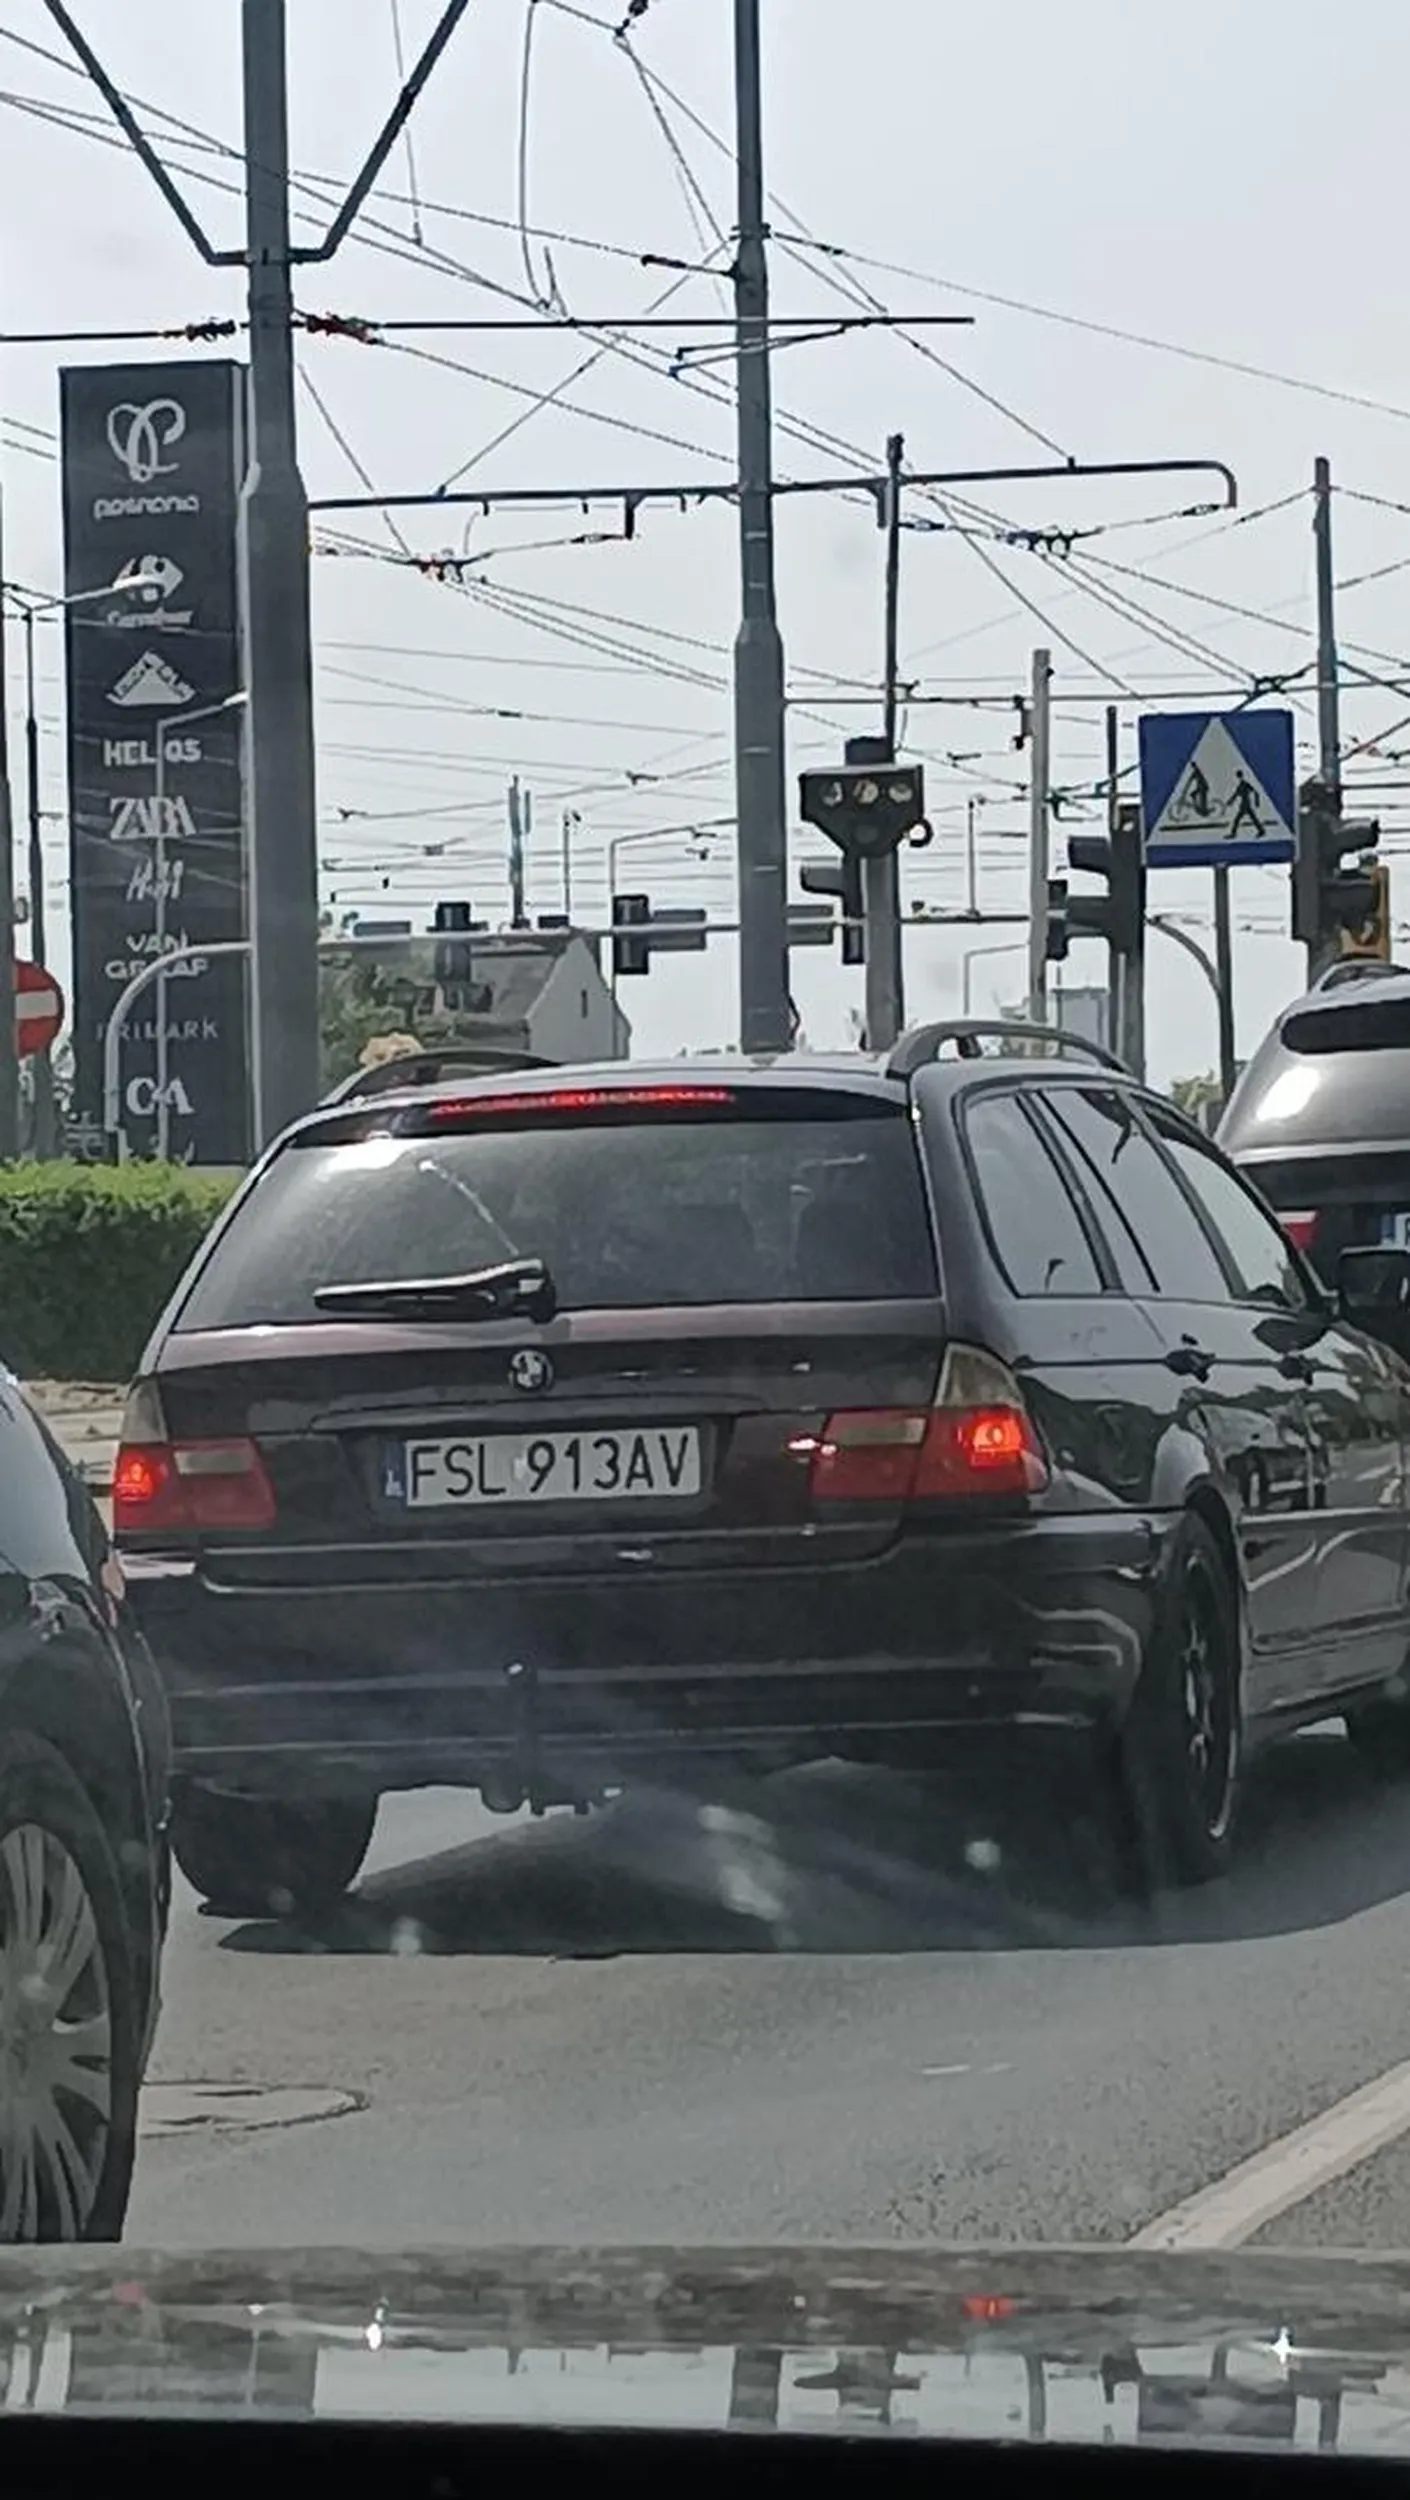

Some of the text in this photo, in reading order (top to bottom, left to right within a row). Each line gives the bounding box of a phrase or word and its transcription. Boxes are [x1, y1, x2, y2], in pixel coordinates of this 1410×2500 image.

[110, 796, 196, 840] ZARA
[411, 1444, 506, 1500] FSL
[527, 1434, 689, 1493] 913AV
